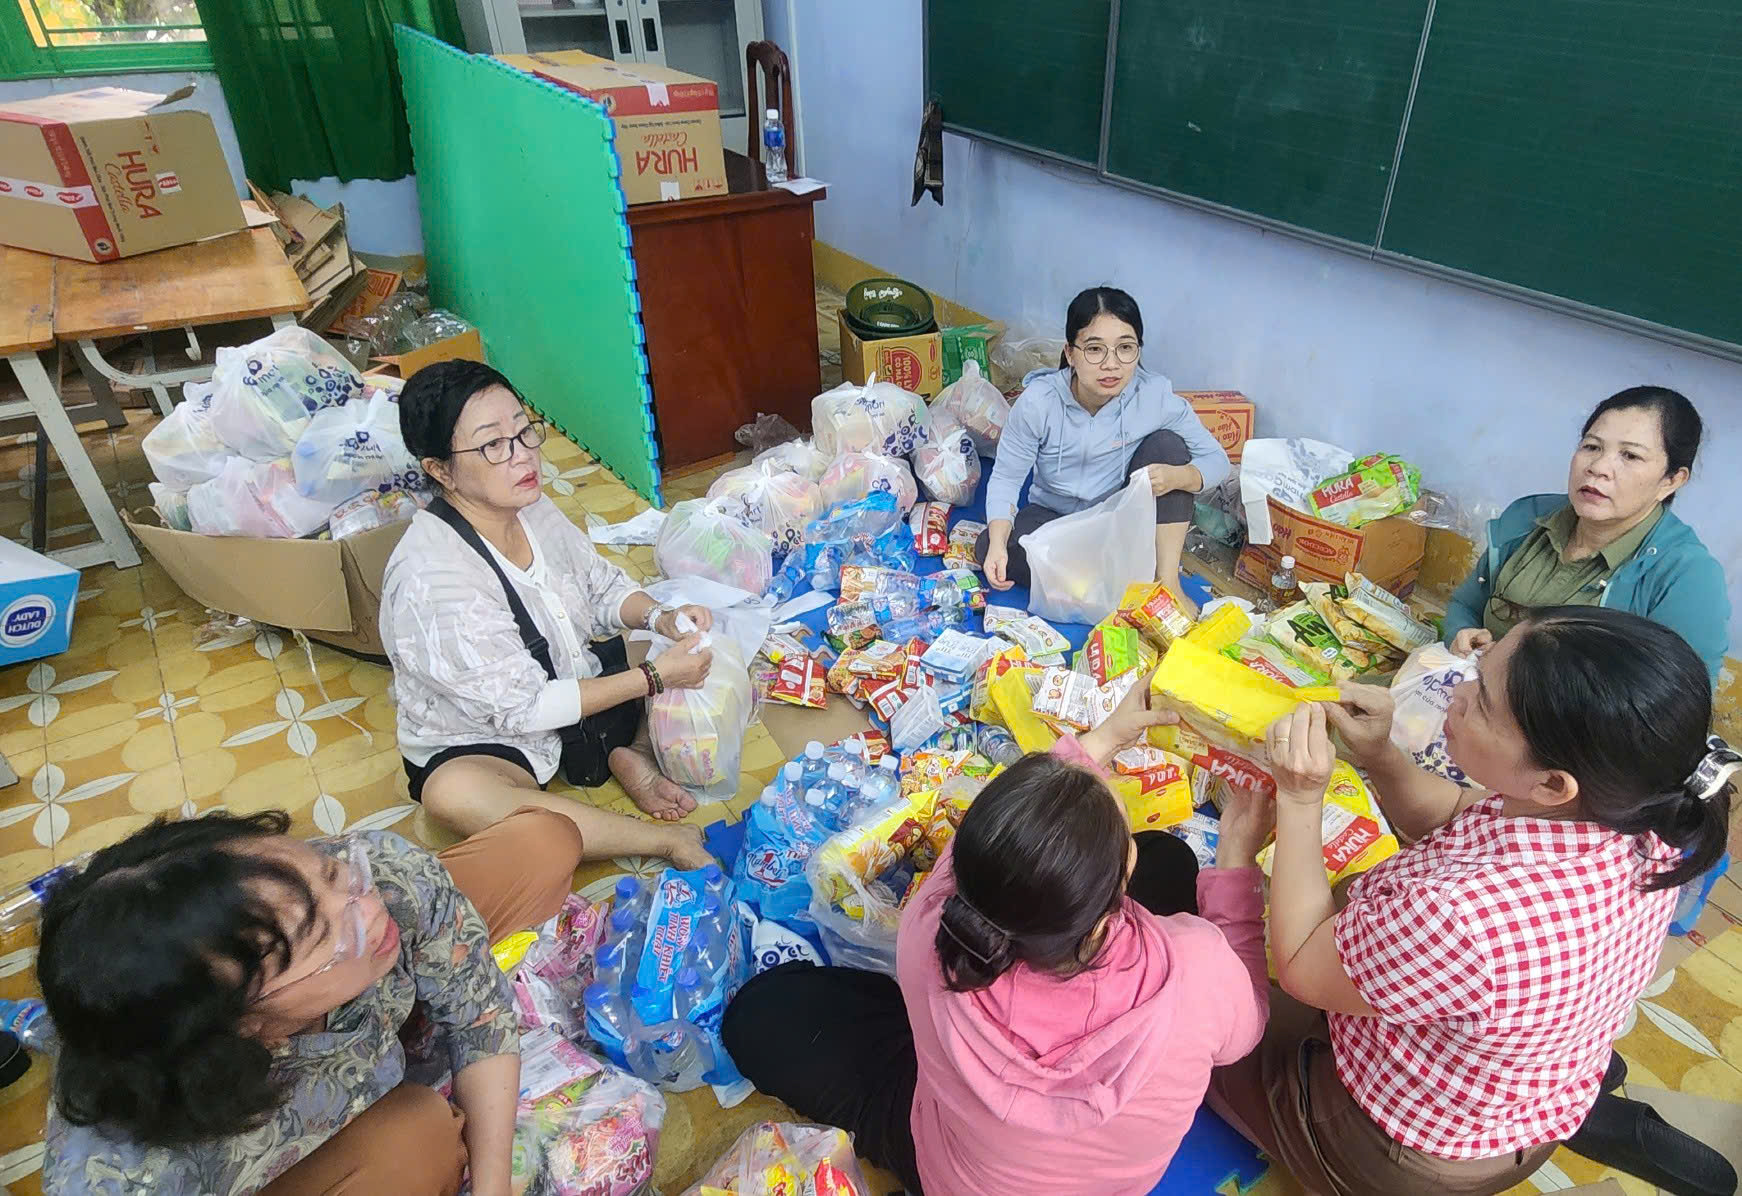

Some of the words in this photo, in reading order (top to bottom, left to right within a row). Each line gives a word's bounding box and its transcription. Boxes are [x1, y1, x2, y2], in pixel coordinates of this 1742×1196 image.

[635, 146, 698, 176] HURA
[116, 150, 162, 220] HURA
[1321, 477, 1354, 498] HURA
[8, 620, 41, 633] DUTCH
[14, 610, 40, 622] LADY
[1331, 826, 1375, 864] HURA
[666, 912, 679, 942] TINH
